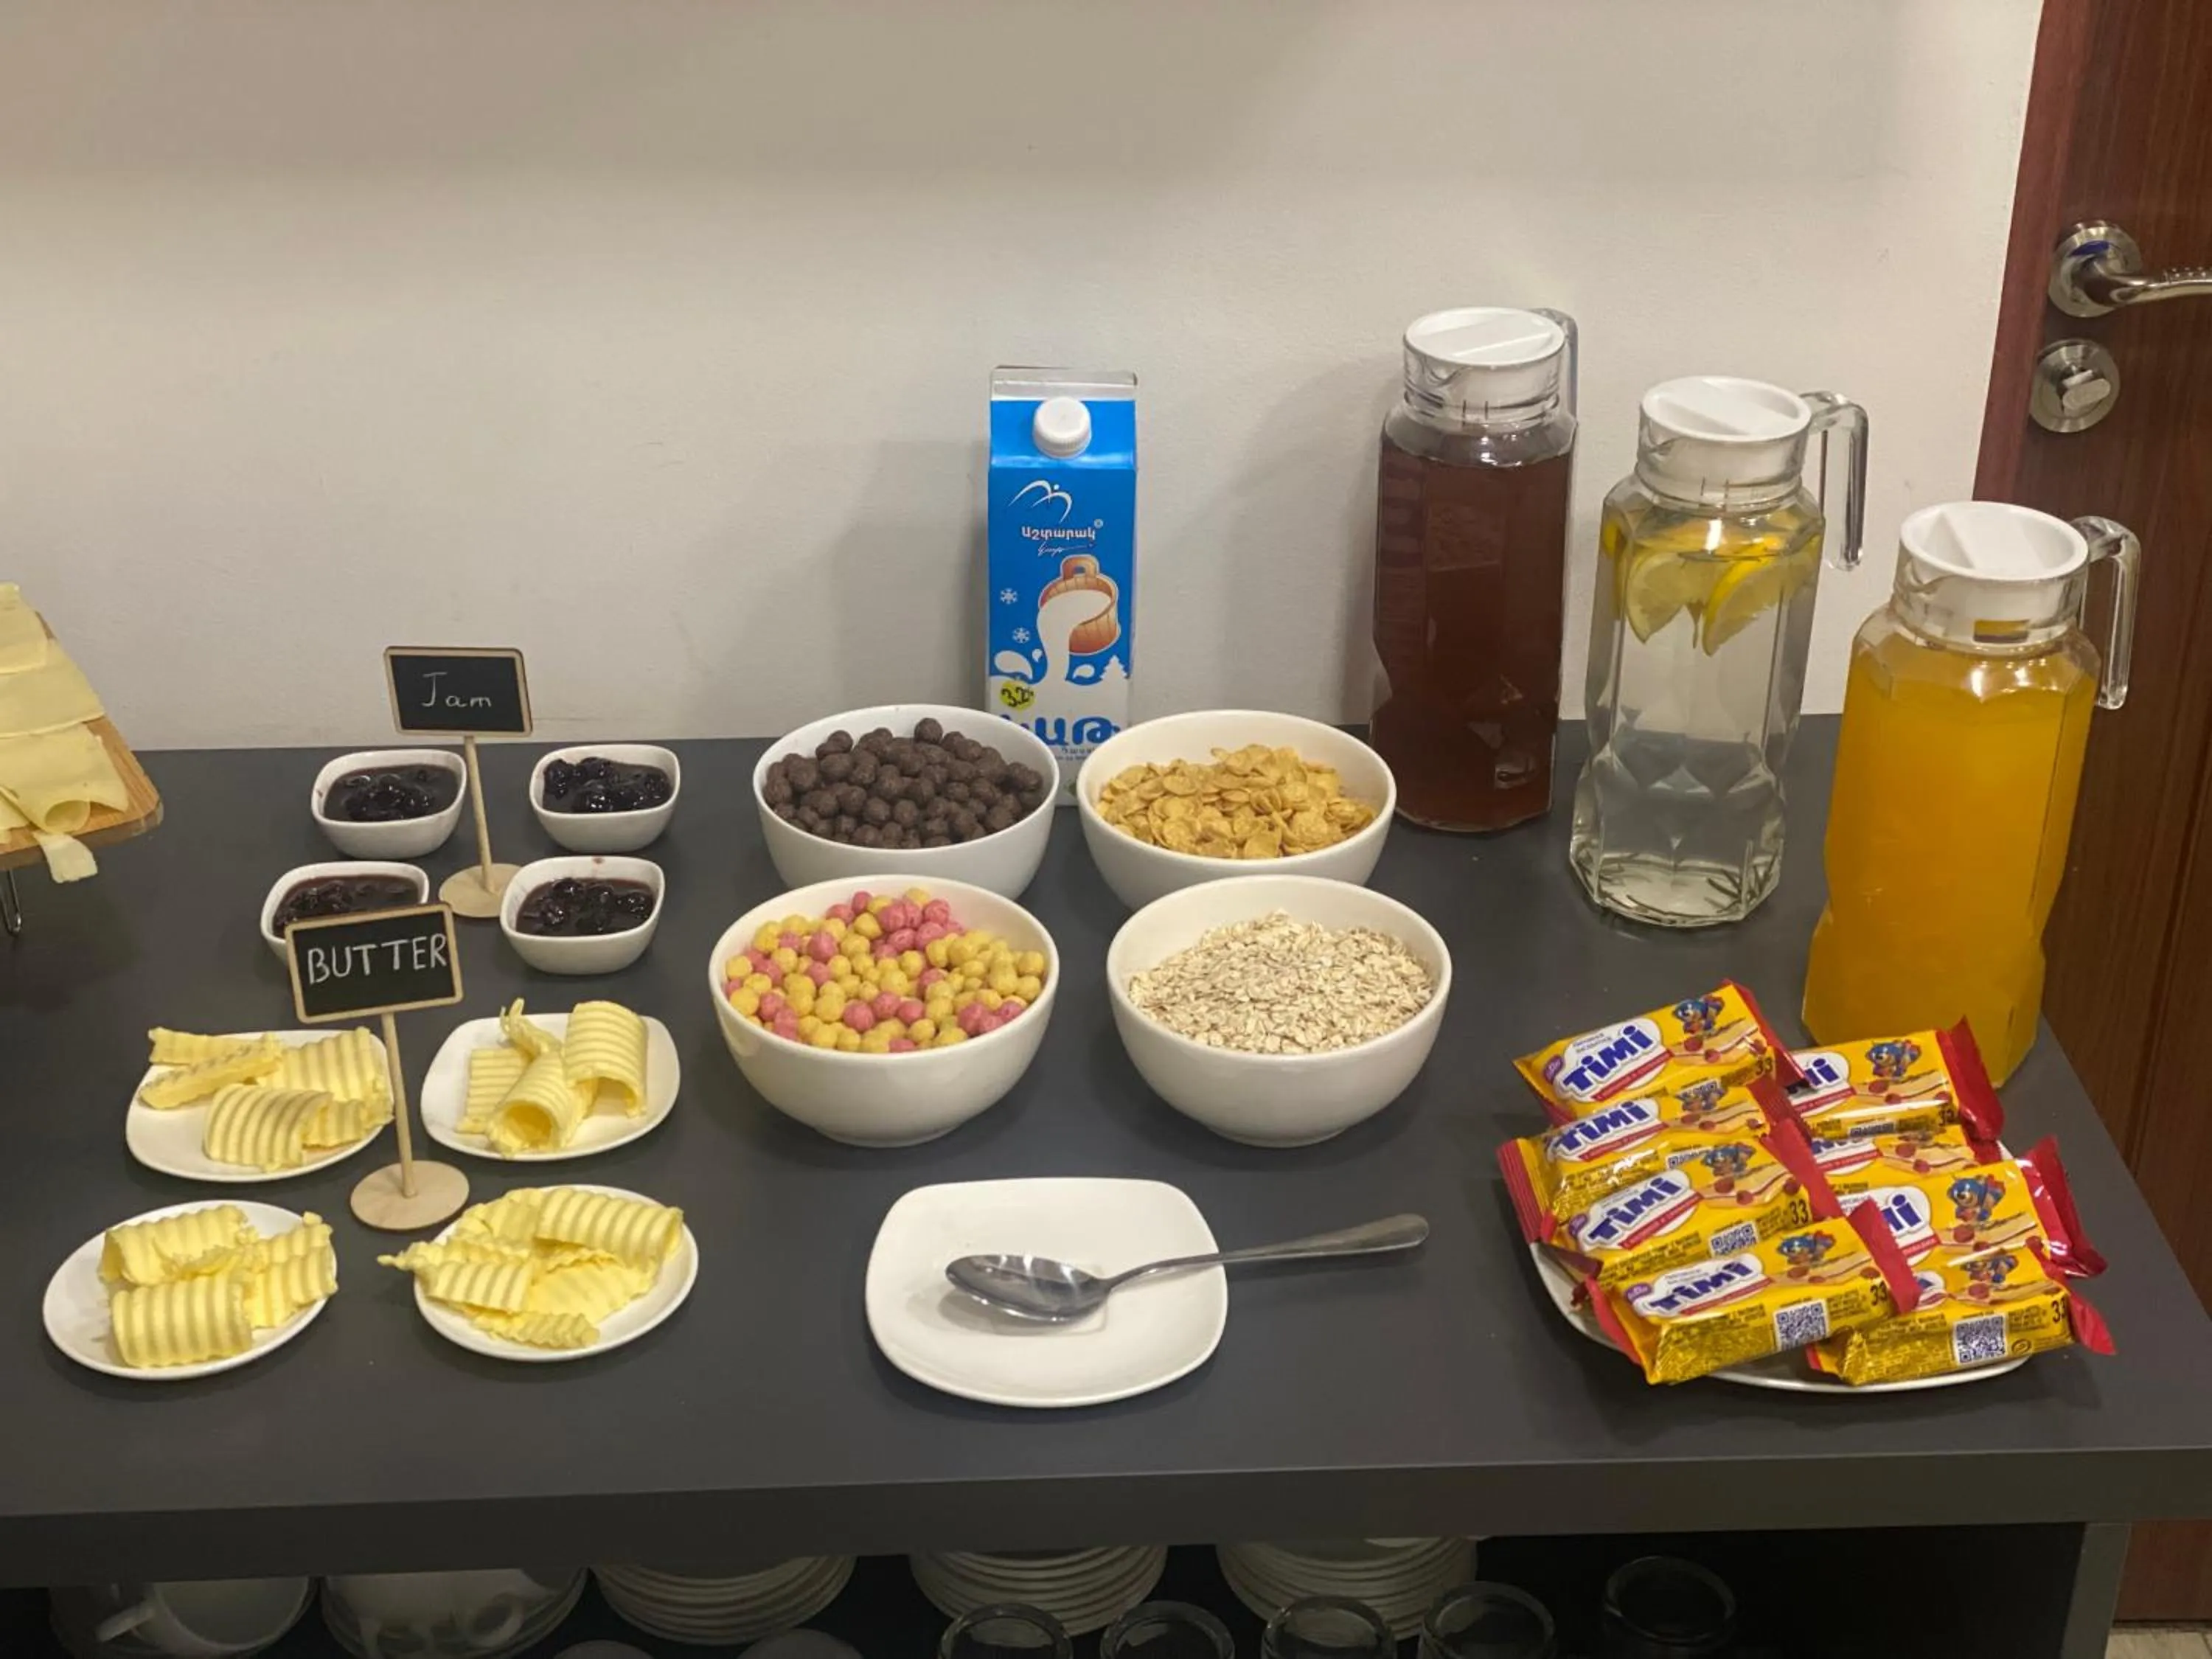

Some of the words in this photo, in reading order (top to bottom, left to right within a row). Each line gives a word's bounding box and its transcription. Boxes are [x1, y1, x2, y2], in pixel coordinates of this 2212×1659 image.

[1021, 526, 1096, 540] Աշտարակ
[420, 671, 493, 709] Jam
[307, 933, 448, 985] BUTTER
[1790, 1199, 1809, 1225] 33
[1870, 1281, 1888, 1307] 33
